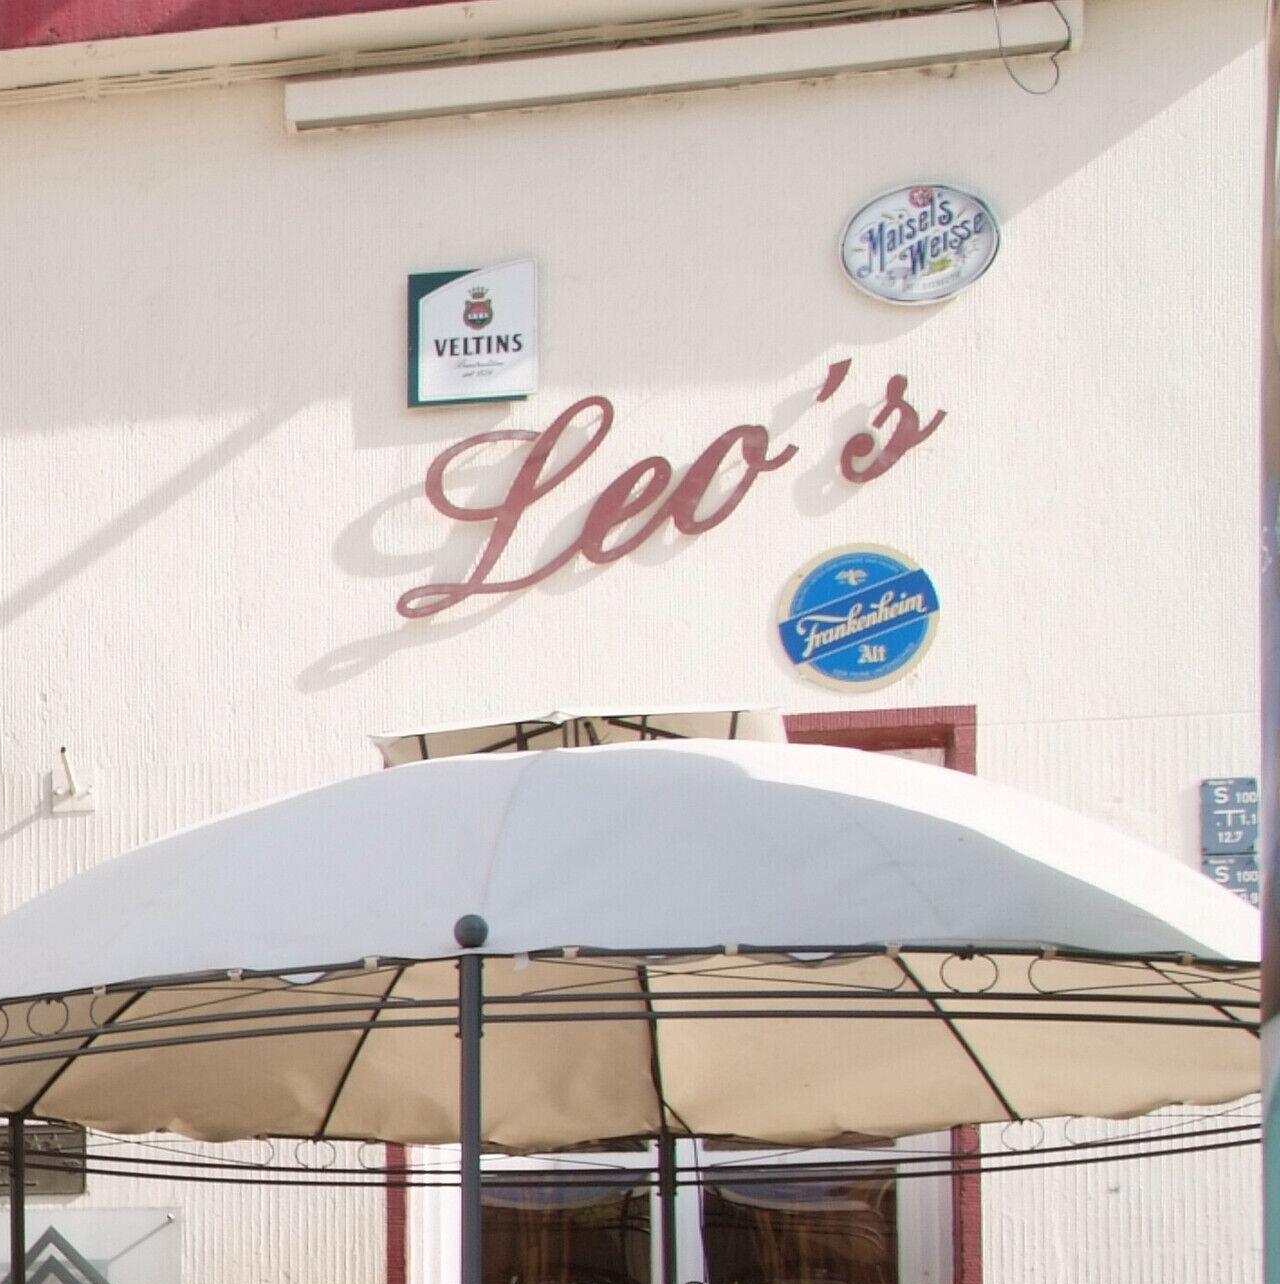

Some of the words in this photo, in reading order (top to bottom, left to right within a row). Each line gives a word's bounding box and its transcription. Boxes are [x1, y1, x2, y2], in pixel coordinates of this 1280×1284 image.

[434, 333, 523, 357] VELTINS
[396, 358, 947, 619] Leo's
[796, 590, 928, 659] Frankenheim
[856, 644, 887, 664] Alt
[1213, 786, 1229, 804] S
[1215, 865, 1231, 883] S
